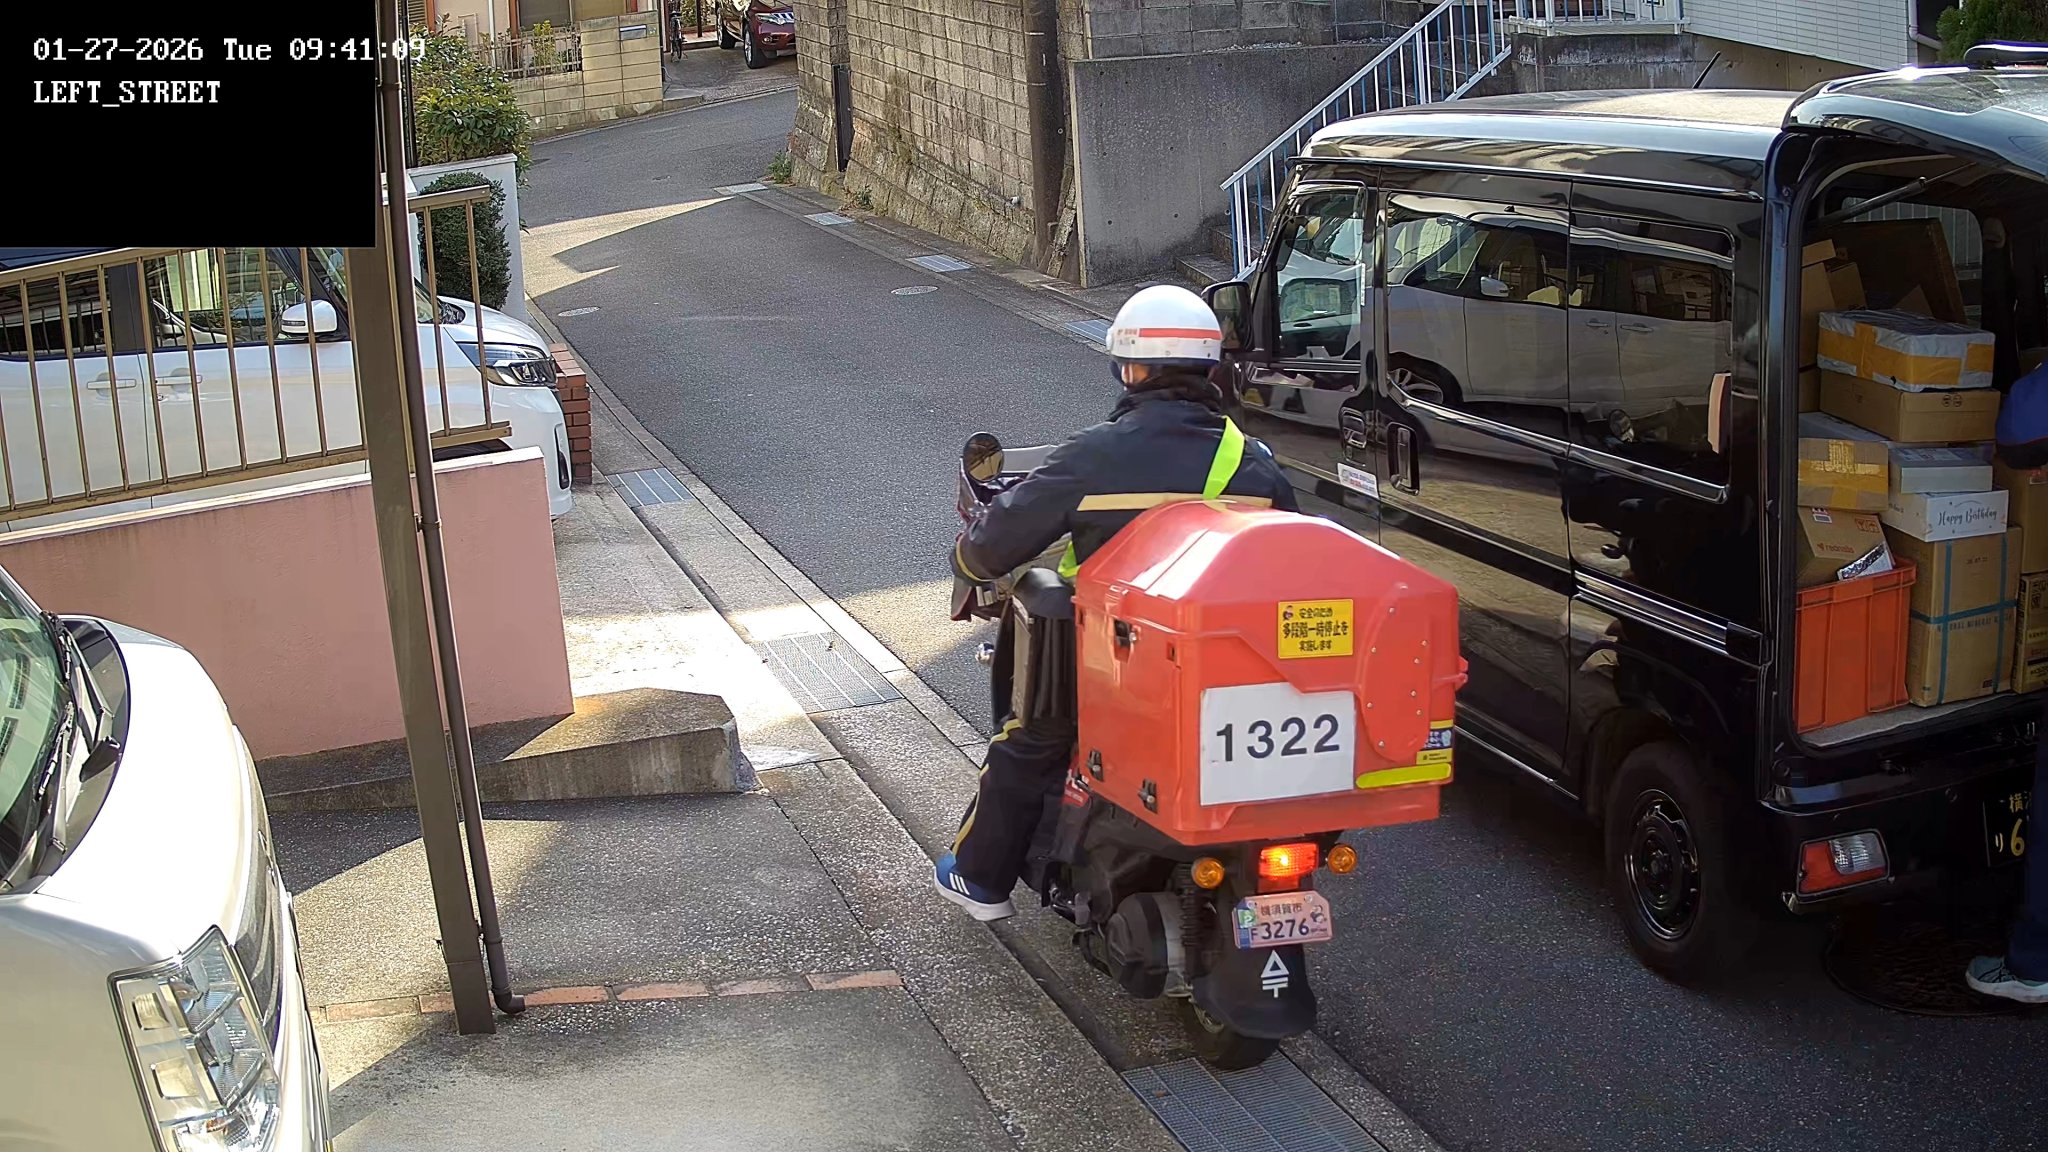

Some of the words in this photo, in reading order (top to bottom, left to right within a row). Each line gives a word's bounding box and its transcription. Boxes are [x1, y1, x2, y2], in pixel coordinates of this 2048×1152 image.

[1937, 510, 1963, 526] Happy
[1965, 506, 1998, 523] Birthday
[1299, 606, 1333, 619] 安全のため
[1283, 620, 1349, 639] 多段階一時停止を
[1216, 713, 1340, 762] 1322
[1260, 902, 1303, 917] 横須賀市
